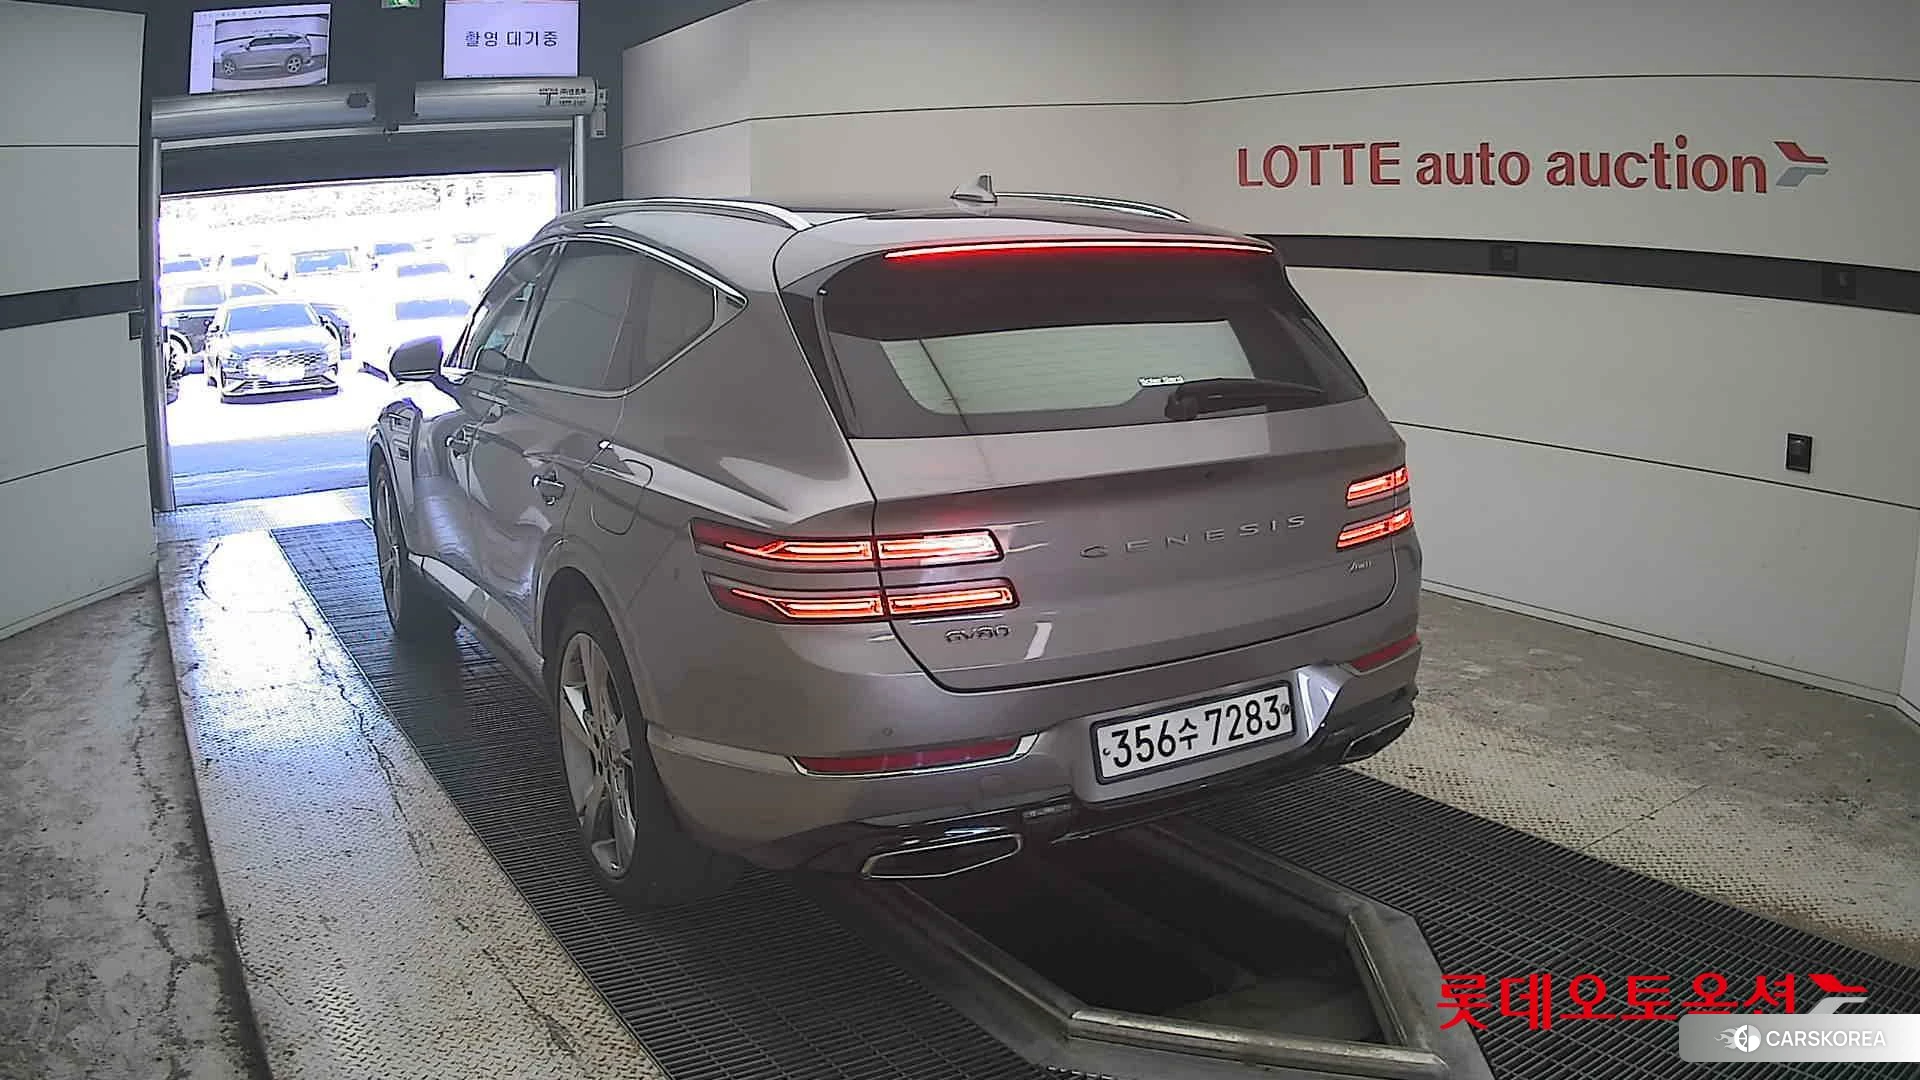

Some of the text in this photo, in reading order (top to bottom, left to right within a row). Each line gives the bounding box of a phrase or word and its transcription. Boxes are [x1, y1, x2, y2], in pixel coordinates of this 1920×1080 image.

[506, 30, 558, 47] 대기중
[1237, 135, 1768, 194] LOTTE auto auction
[1080, 515, 1305, 558] GENESIS
[944, 624, 1010, 643] GV80
